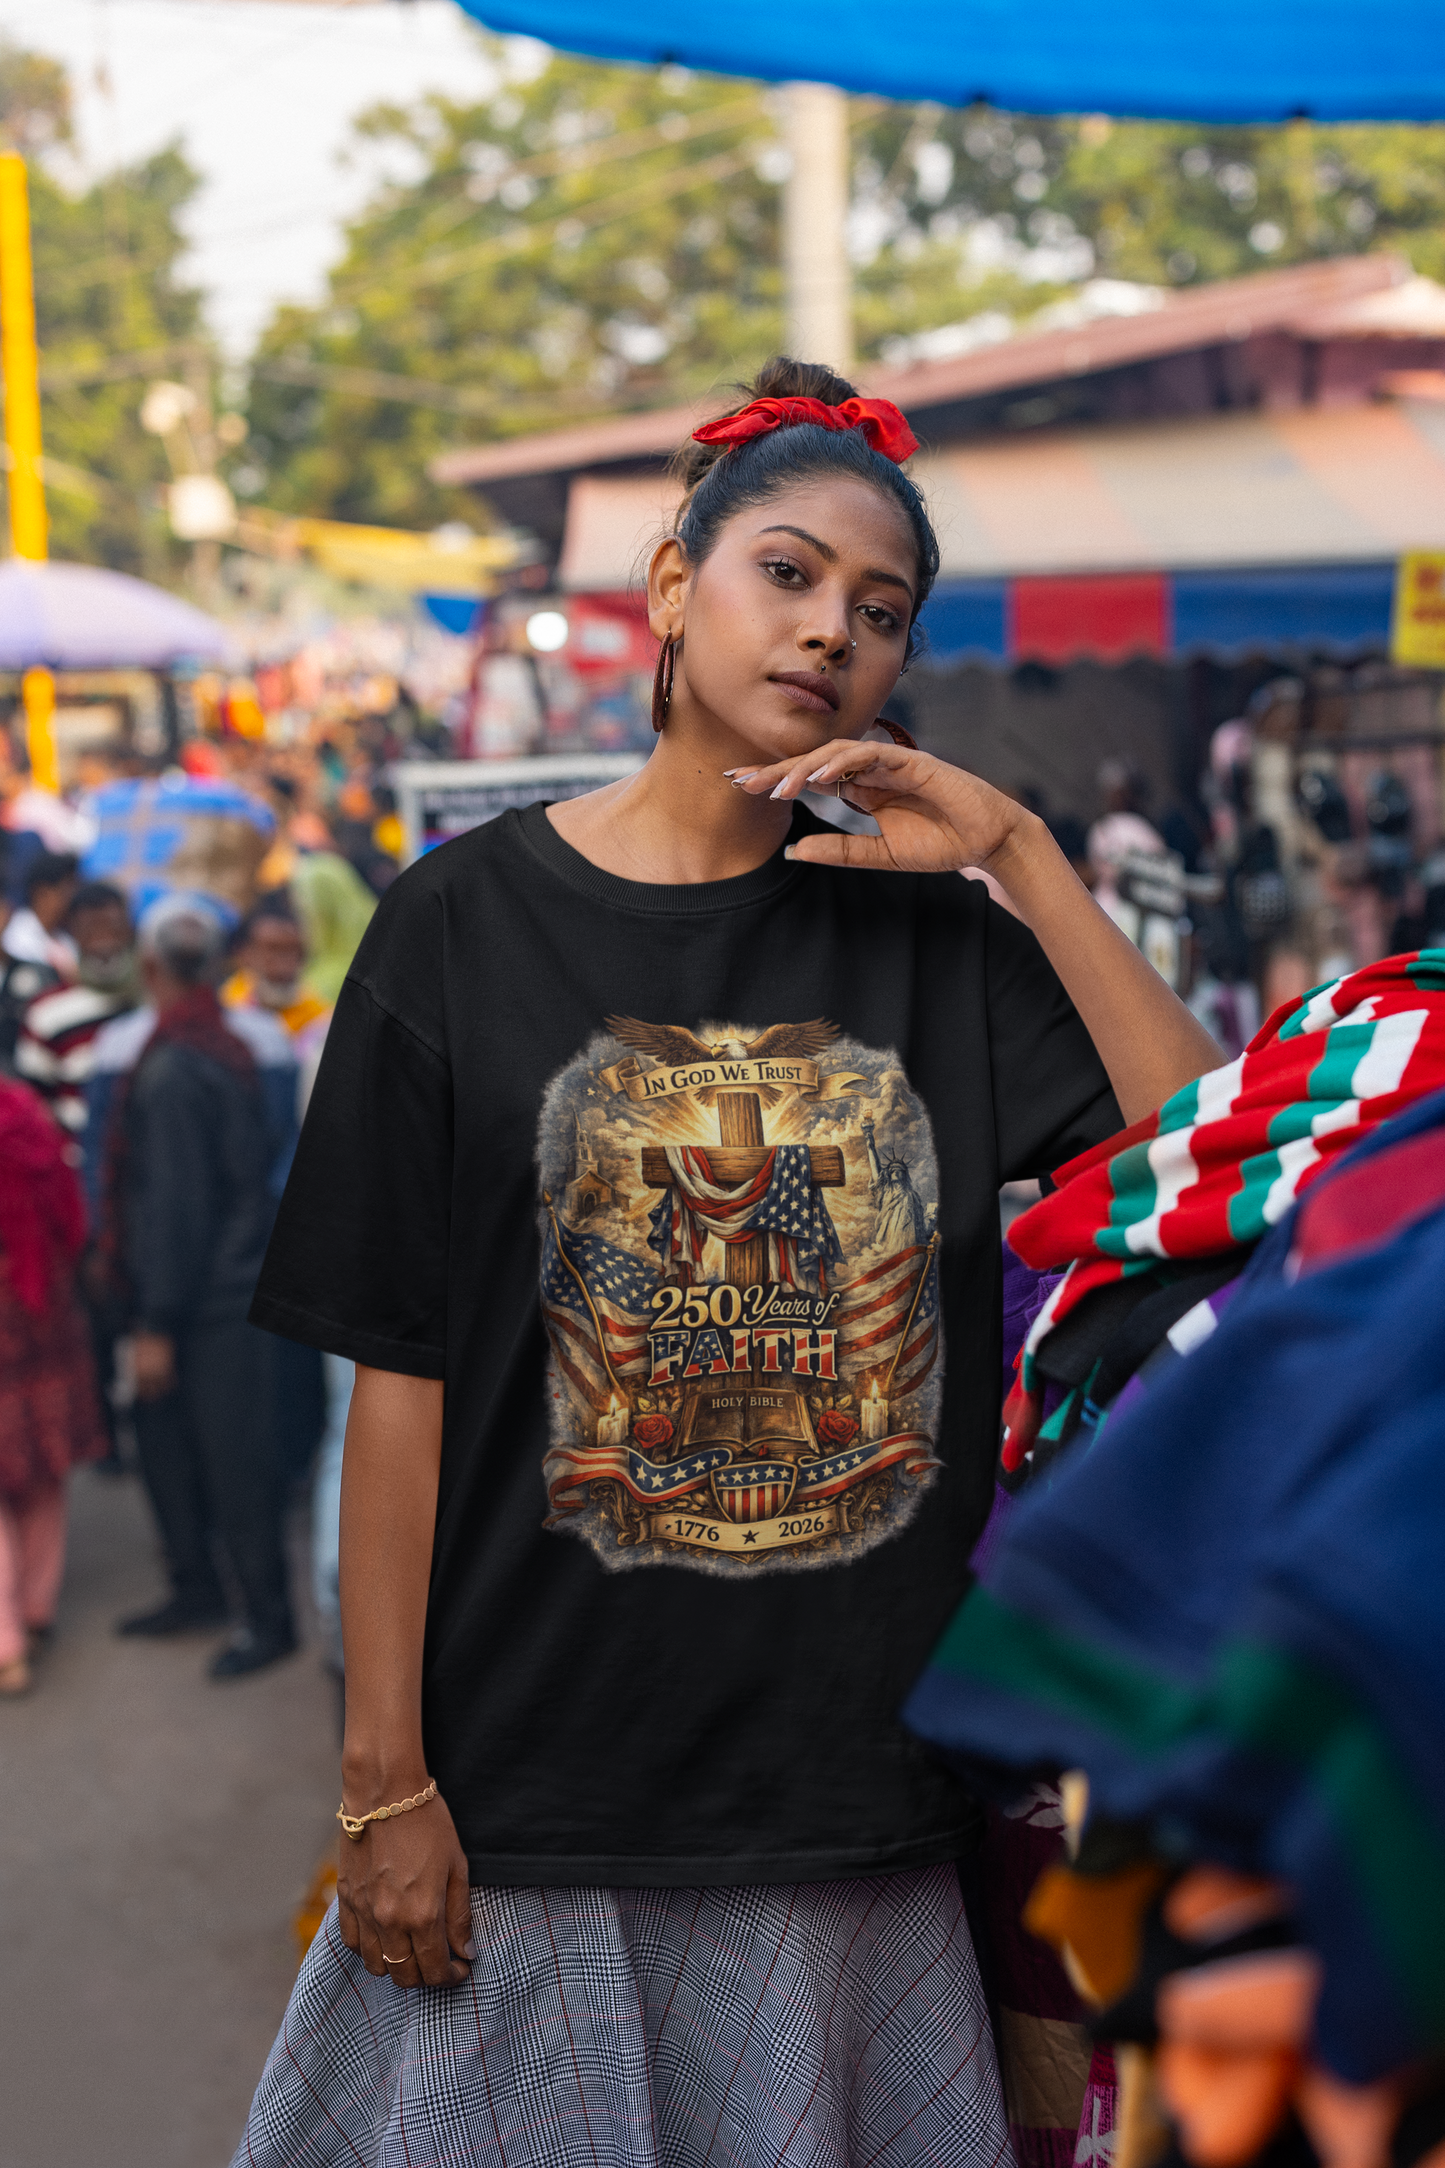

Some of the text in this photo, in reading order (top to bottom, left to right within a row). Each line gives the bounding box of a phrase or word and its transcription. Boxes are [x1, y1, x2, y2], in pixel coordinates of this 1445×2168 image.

[670, 1069, 716, 1089] GOD
[753, 1061, 802, 1081] TRUST
[650, 1284, 841, 1331] 250 Years of
[647, 1327, 839, 1387] FAITH
[711, 1395, 784, 1409] HOLY BIBLE
[674, 1515, 825, 1542] 1776 2026
